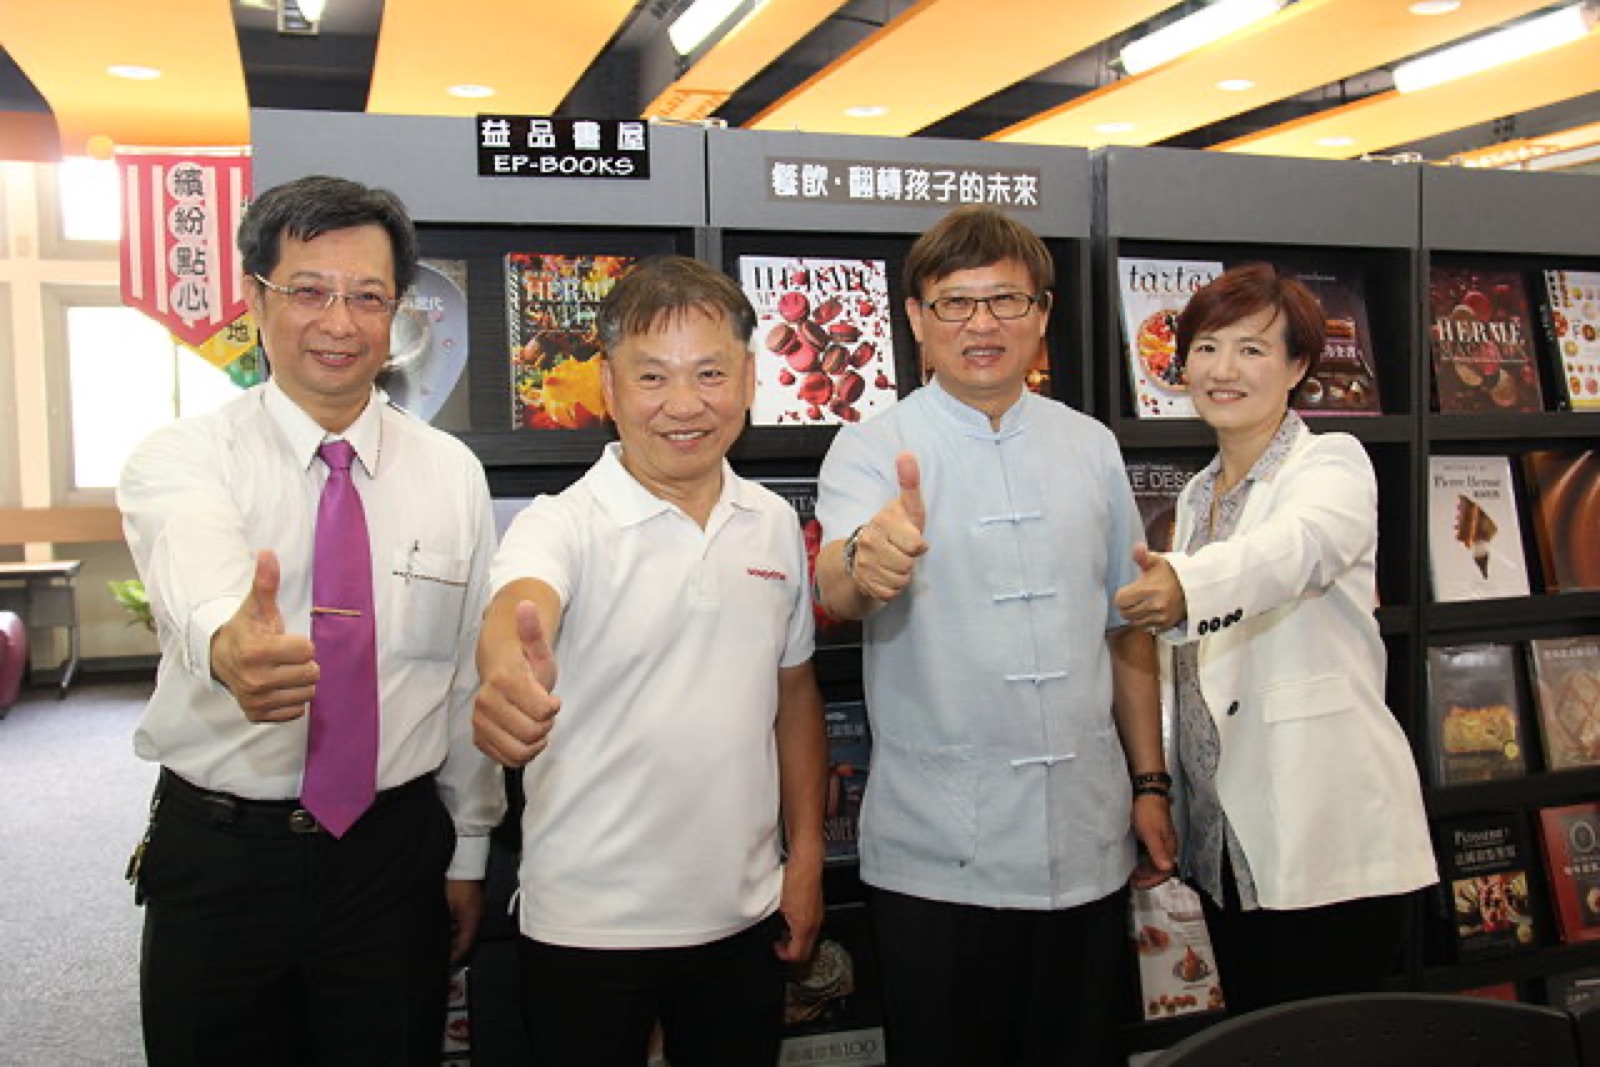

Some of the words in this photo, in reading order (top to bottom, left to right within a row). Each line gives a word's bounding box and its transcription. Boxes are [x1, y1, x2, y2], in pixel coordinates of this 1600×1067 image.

[481, 119, 646, 151] 益品書屋
[493, 154, 635, 176] EP-BOOKS
[174, 166, 209, 311] 繽紛點心
